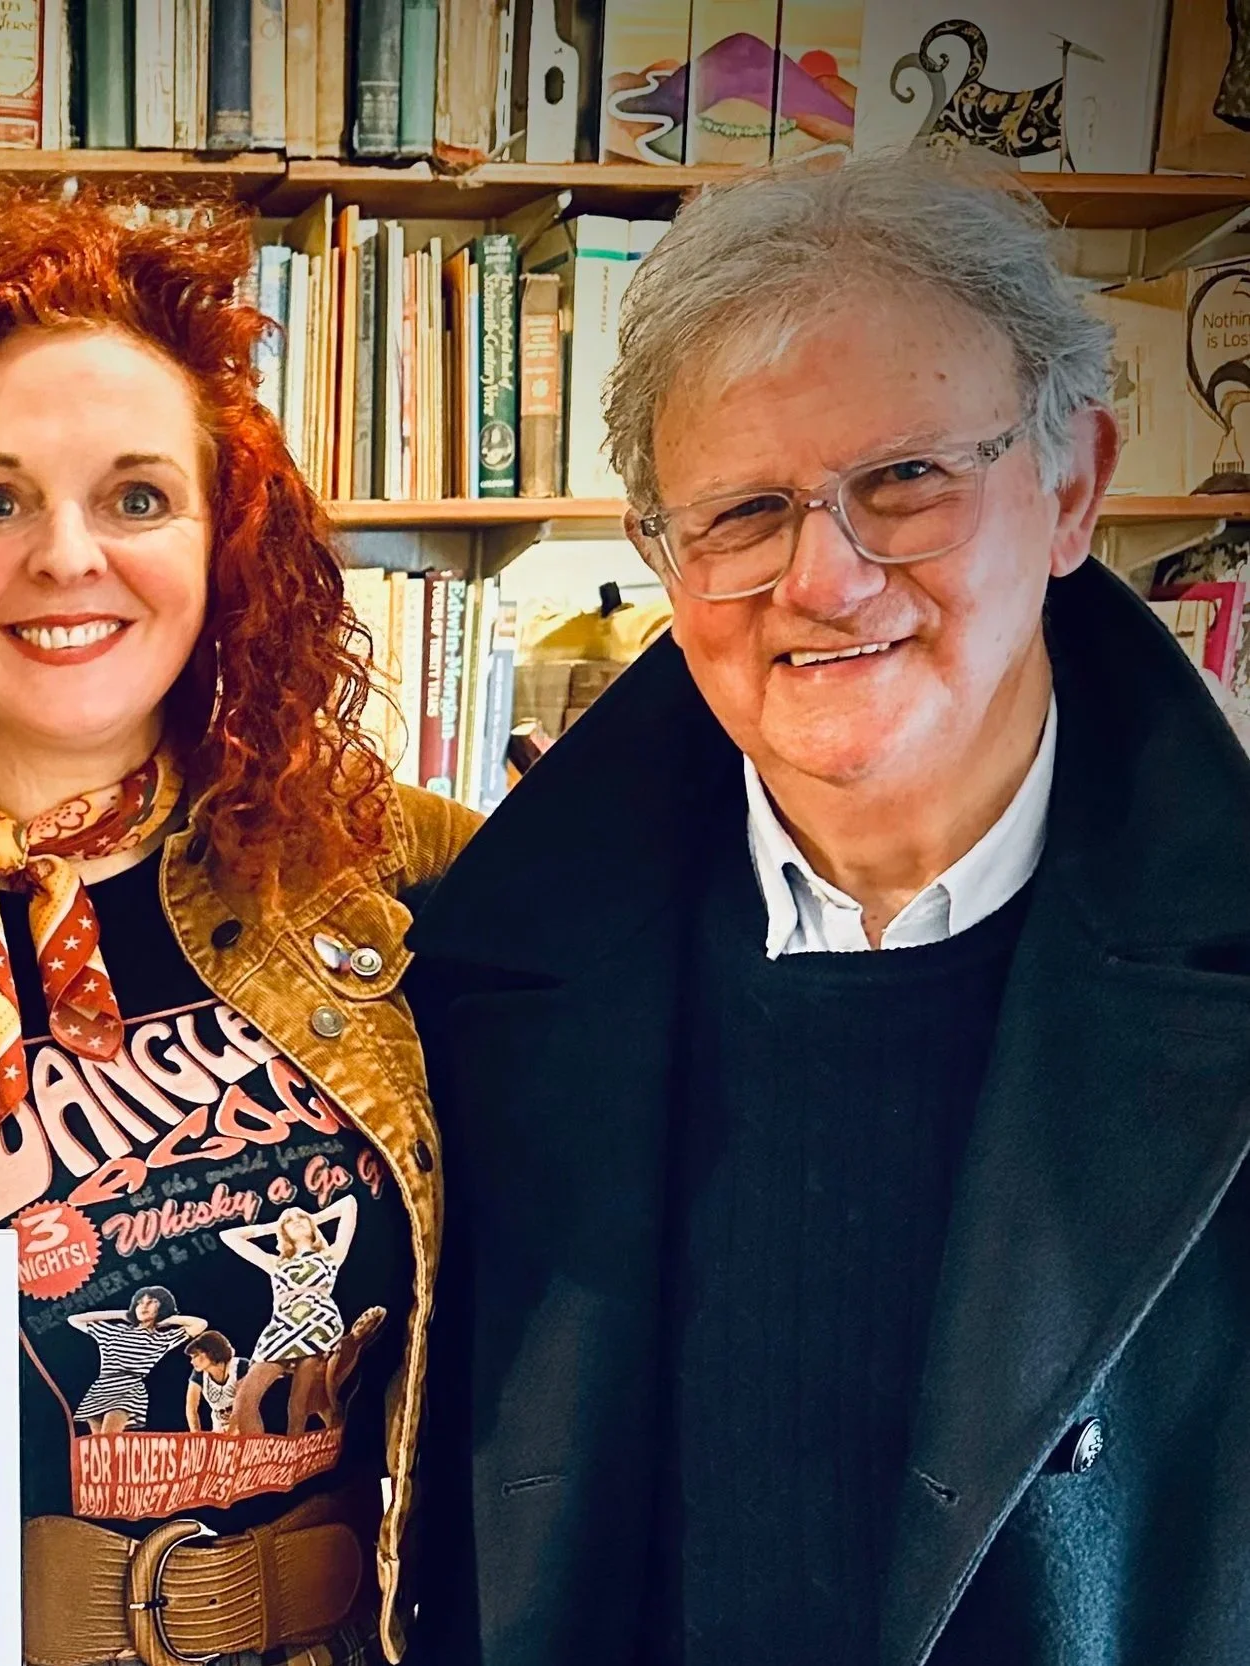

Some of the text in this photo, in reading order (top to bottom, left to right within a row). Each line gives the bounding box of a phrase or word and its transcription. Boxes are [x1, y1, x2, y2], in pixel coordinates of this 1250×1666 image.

[1207, 332, 1250, 349] is Los
[440, 580, 466, 740] Edwin Morgan
[146, 1058, 347, 1169] GO-G
[101, 1183, 262, 1257] Whisky
[267, 1176, 297, 1205] a
[303, 1155, 354, 1209] Go
[20, 1208, 70, 1253] 3
[18, 1240, 92, 1285] NIGHTS!
[79, 1436, 112, 1485] FOR
[115, 1435, 177, 1485] TICKETS
[179, 1437, 207, 1480] AND
[79, 1483, 110, 1516] 8901
[113, 1483, 169, 1517] SUNSET
